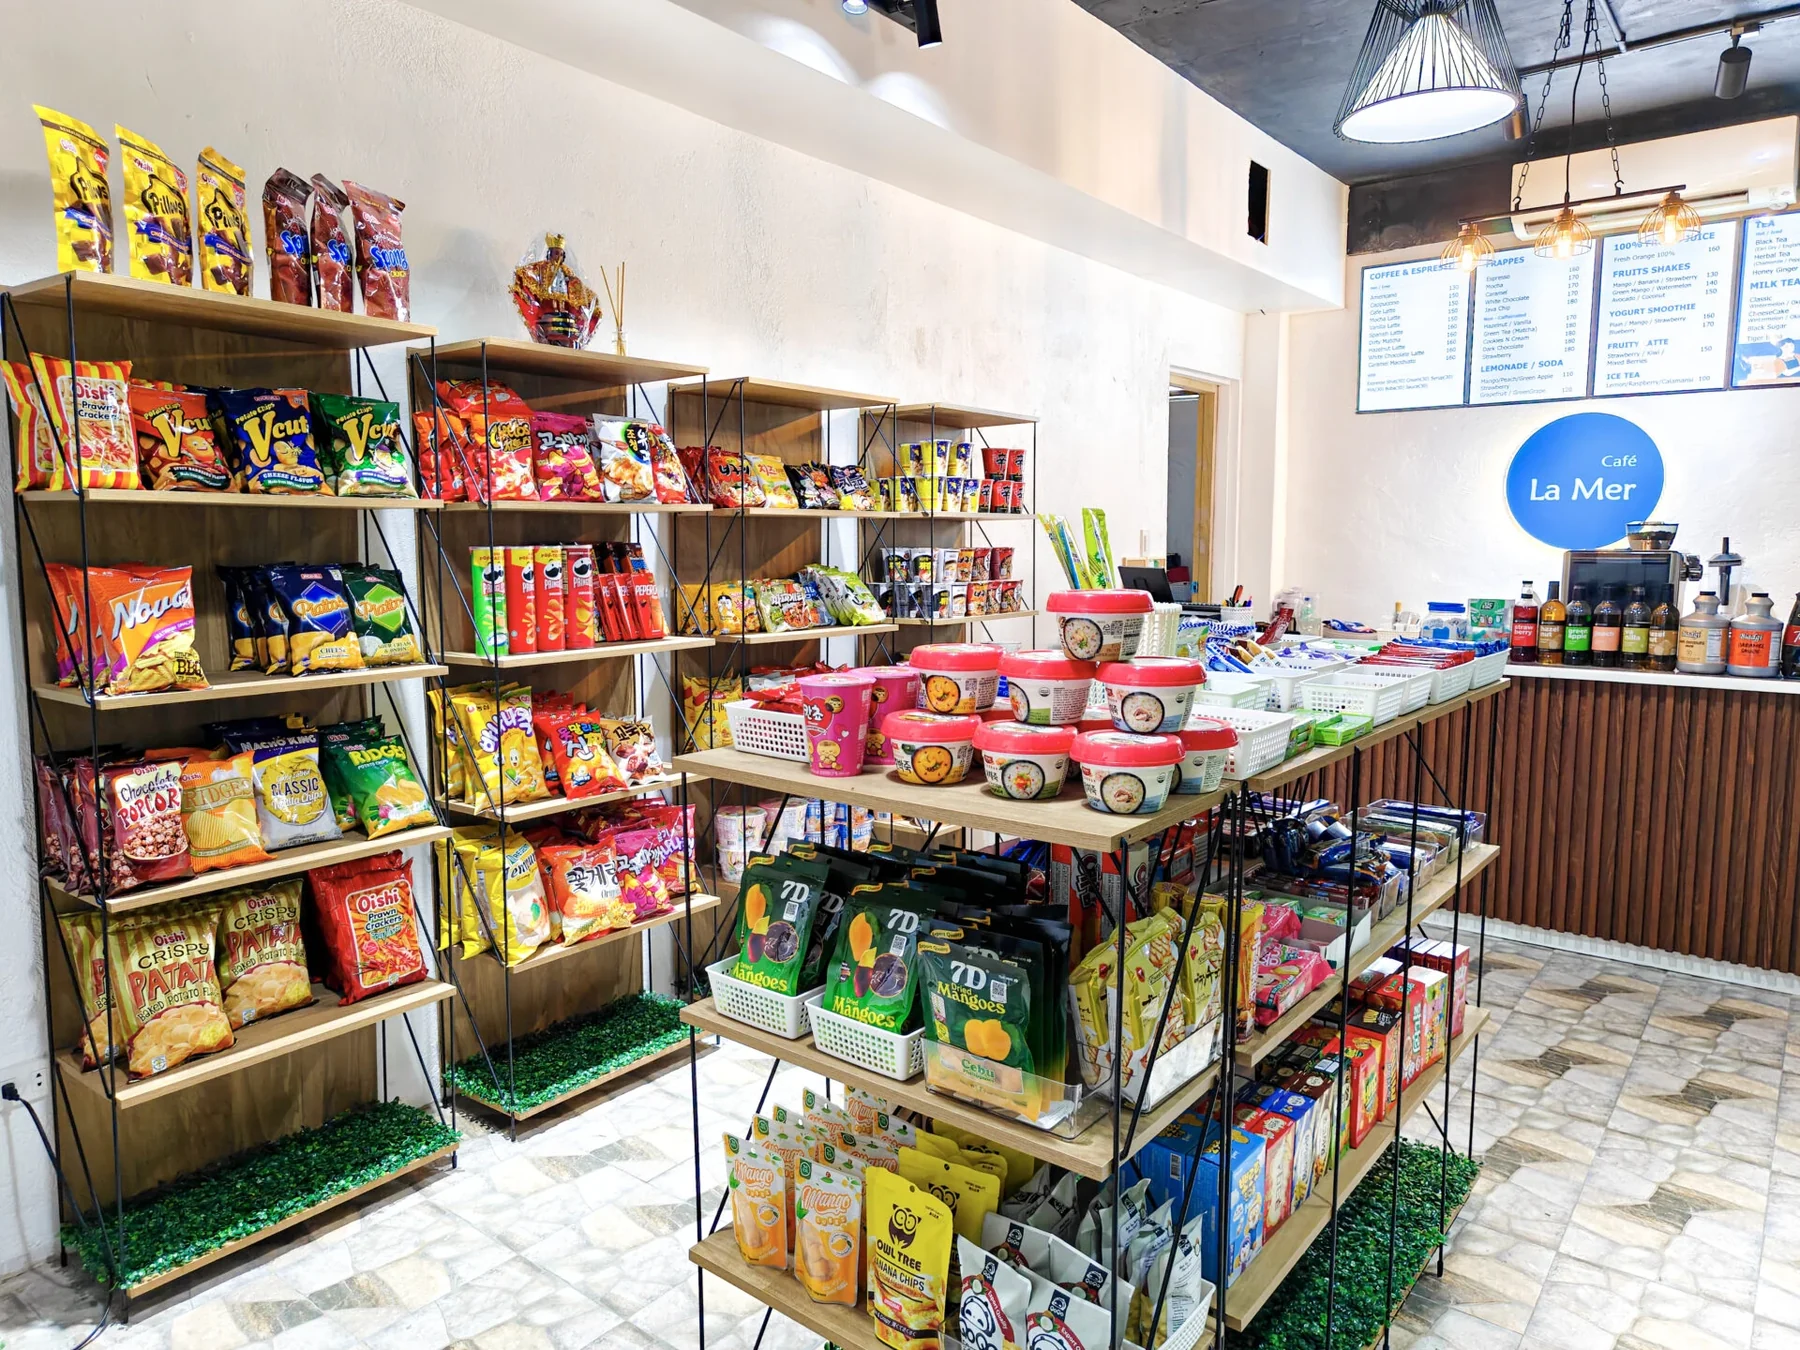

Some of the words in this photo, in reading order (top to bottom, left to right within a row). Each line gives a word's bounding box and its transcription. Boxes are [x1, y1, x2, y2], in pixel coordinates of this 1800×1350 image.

[1755, 220, 1775, 228] TEA
[1614, 242, 1642, 251] 100%
[1685, 232, 1715, 242] JUICE
[1486, 256, 1525, 267] FRAPPES
[1632, 253, 1655, 261] Orange
[1370, 270, 1400, 280] COFFEE
[1613, 267, 1649, 278] FRUITS
[1651, 263, 1691, 273] SHAKES
[1666, 274, 1698, 283] Strawberry
[1753, 268, 1773, 276] Honey
[1750, 280, 1777, 290] MILK
[1609, 308, 1645, 317] YOGURT
[1648, 303, 1696, 314] SMOOTHIE
[1608, 341, 1639, 350] FRUITY
[1481, 362, 1528, 372] LEMONADE
[1538, 359, 1563, 368] SODA
[236, 411, 257, 425] Potato
[257, 402, 275, 413] Chips
[336, 412, 357, 425] Potato
[357, 405, 373, 415] Chips
[1601, 454, 1638, 467] Café
[263, 472, 290, 481] CHEESE
[290, 475, 314, 484] FLAVOR
[1530, 478, 1561, 501] La
[1571, 478, 1637, 501] Mer
[112, 587, 189, 641] Nova
[1514, 629, 1532, 637] berry
[1567, 633, 1587, 641] apple
[241, 739, 287, 752] NACHO
[288, 734, 317, 746] KING
[133, 764, 157, 777] Oishi
[120, 770, 178, 803] Chocolate
[185, 779, 253, 809] RIDGES
[271, 777, 319, 797] CLASSIC
[301, 791, 323, 803] Chips
[117, 788, 182, 830] POPCOR
[357, 888, 400, 913] Oishi
[780, 880, 810, 904] 7D
[248, 895, 277, 910] Oishi
[364, 914, 402, 932] Crackers
[368, 908, 397, 921] Prawn
[888, 908, 919, 934] 7D
[154, 931, 186, 947] Oishi
[127, 956, 216, 1010] PATATA
[950, 960, 987, 990] 7D
[937, 981, 1006, 1015] Mangoes
[951, 983, 972, 995] Dried
[832, 995, 896, 1028] Mangoes
[962, 1059, 995, 1078] Cebu
[734, 1159, 775, 1184] Mango
[800, 1185, 852, 1212] Mango
[877, 1239, 897, 1259] OWL
[898, 1251, 922, 1272] TREE
[875, 1257, 898, 1279] ANANA
[899, 1272, 925, 1292] CHIPS
[988, 1292, 999, 1313] Export
[995, 1309, 1008, 1330] Quality
[1061, 1327, 1075, 1342] Export
